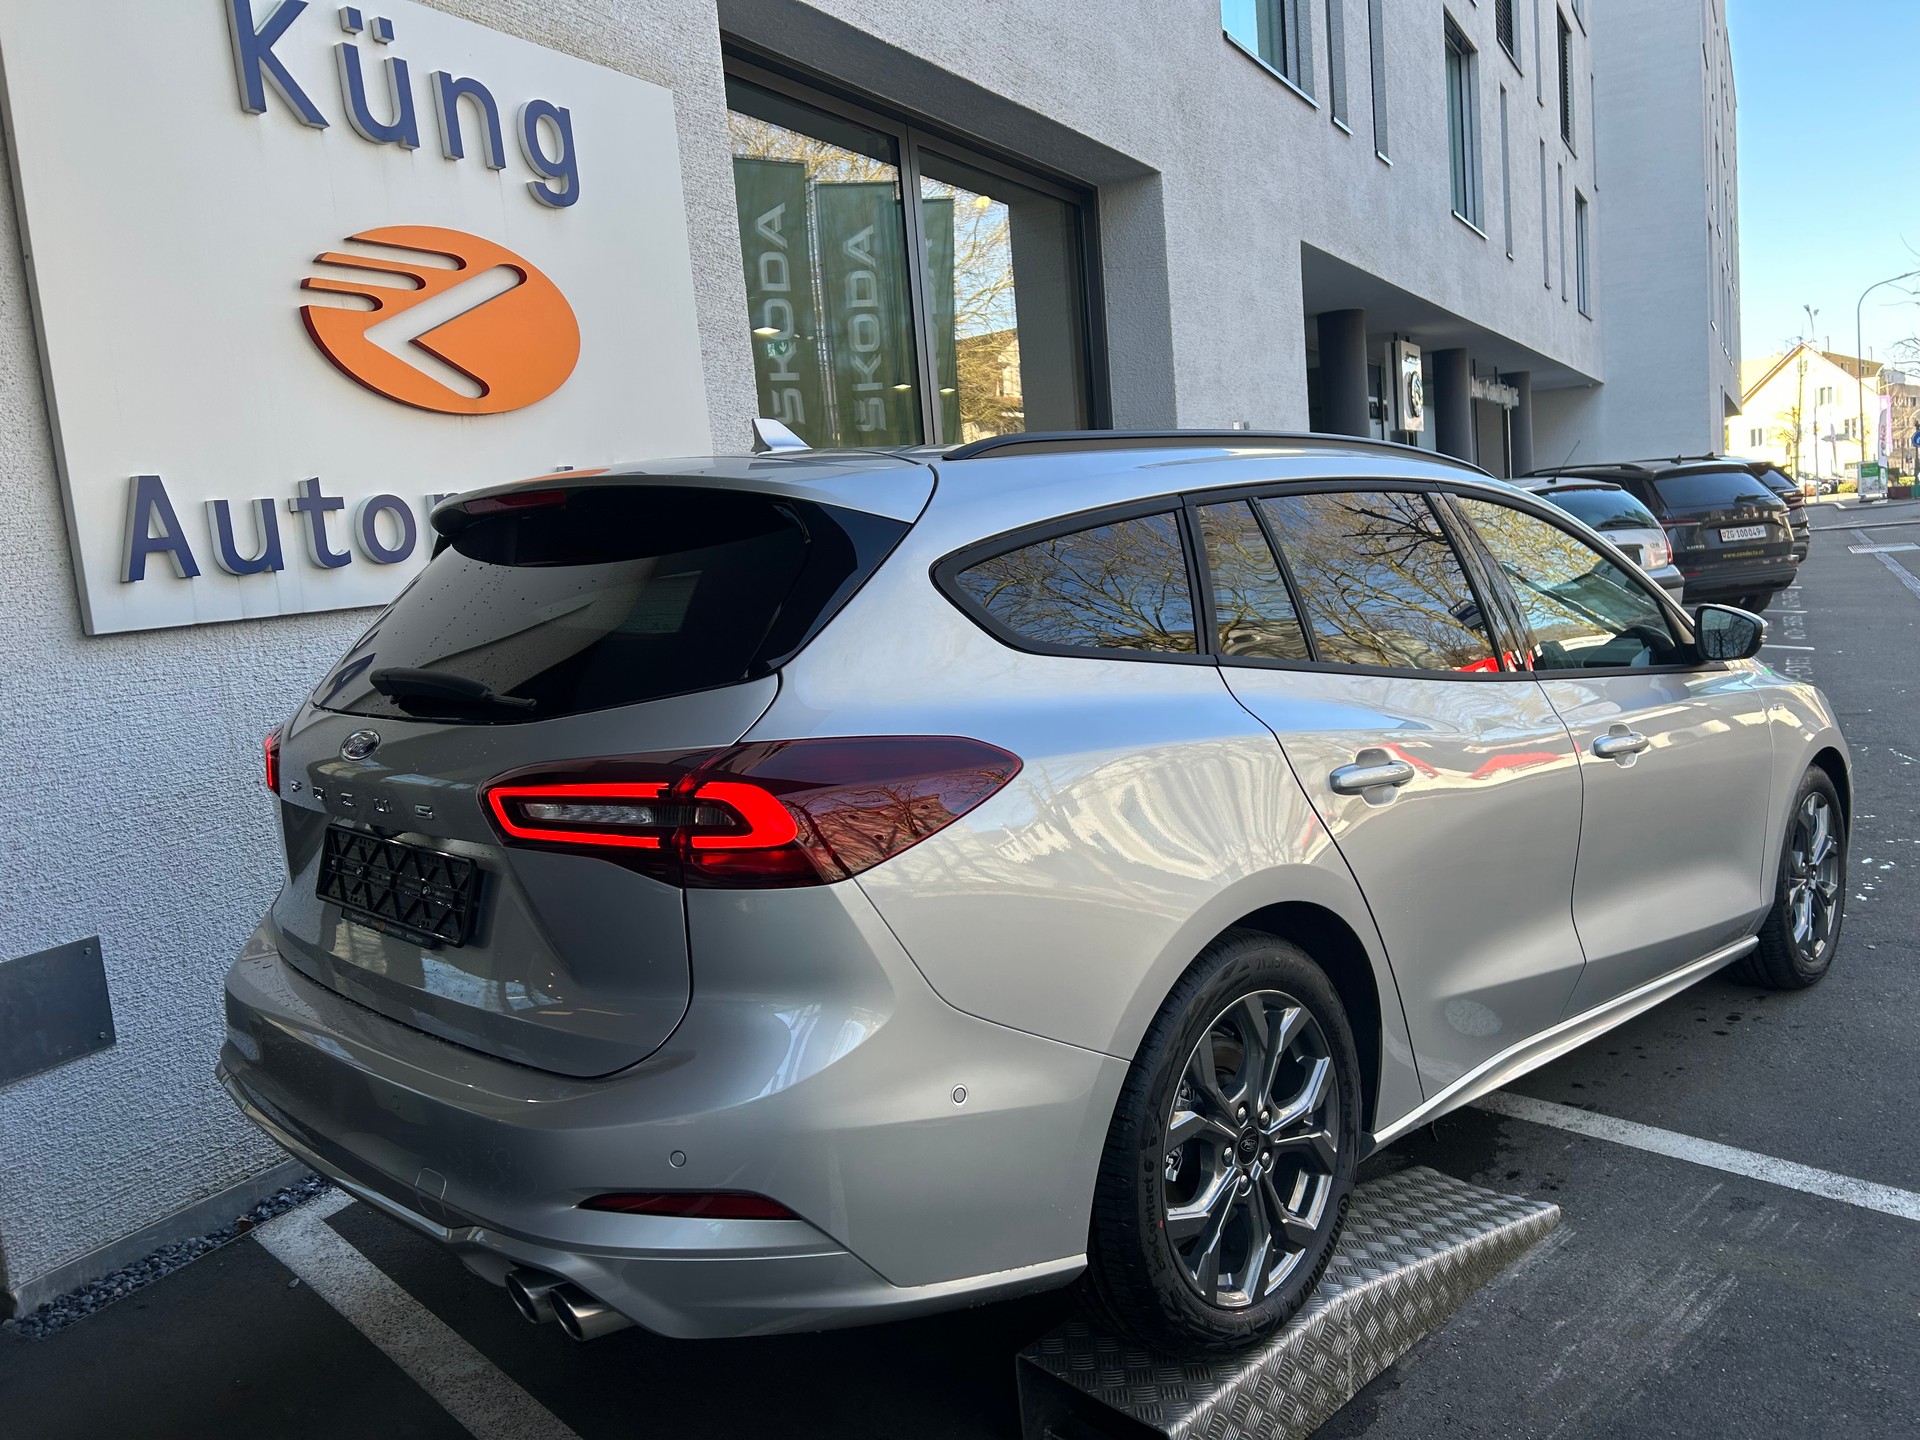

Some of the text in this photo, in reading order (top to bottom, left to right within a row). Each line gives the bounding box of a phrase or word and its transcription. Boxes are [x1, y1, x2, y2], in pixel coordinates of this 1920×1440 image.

[226, 0, 580, 208] Küng
[121, 473, 459, 583] Auto
[290, 779, 434, 820] FOCUS
[1143, 1160, 1155, 1172] 6
[1299, 1192, 1350, 1302] Continental
